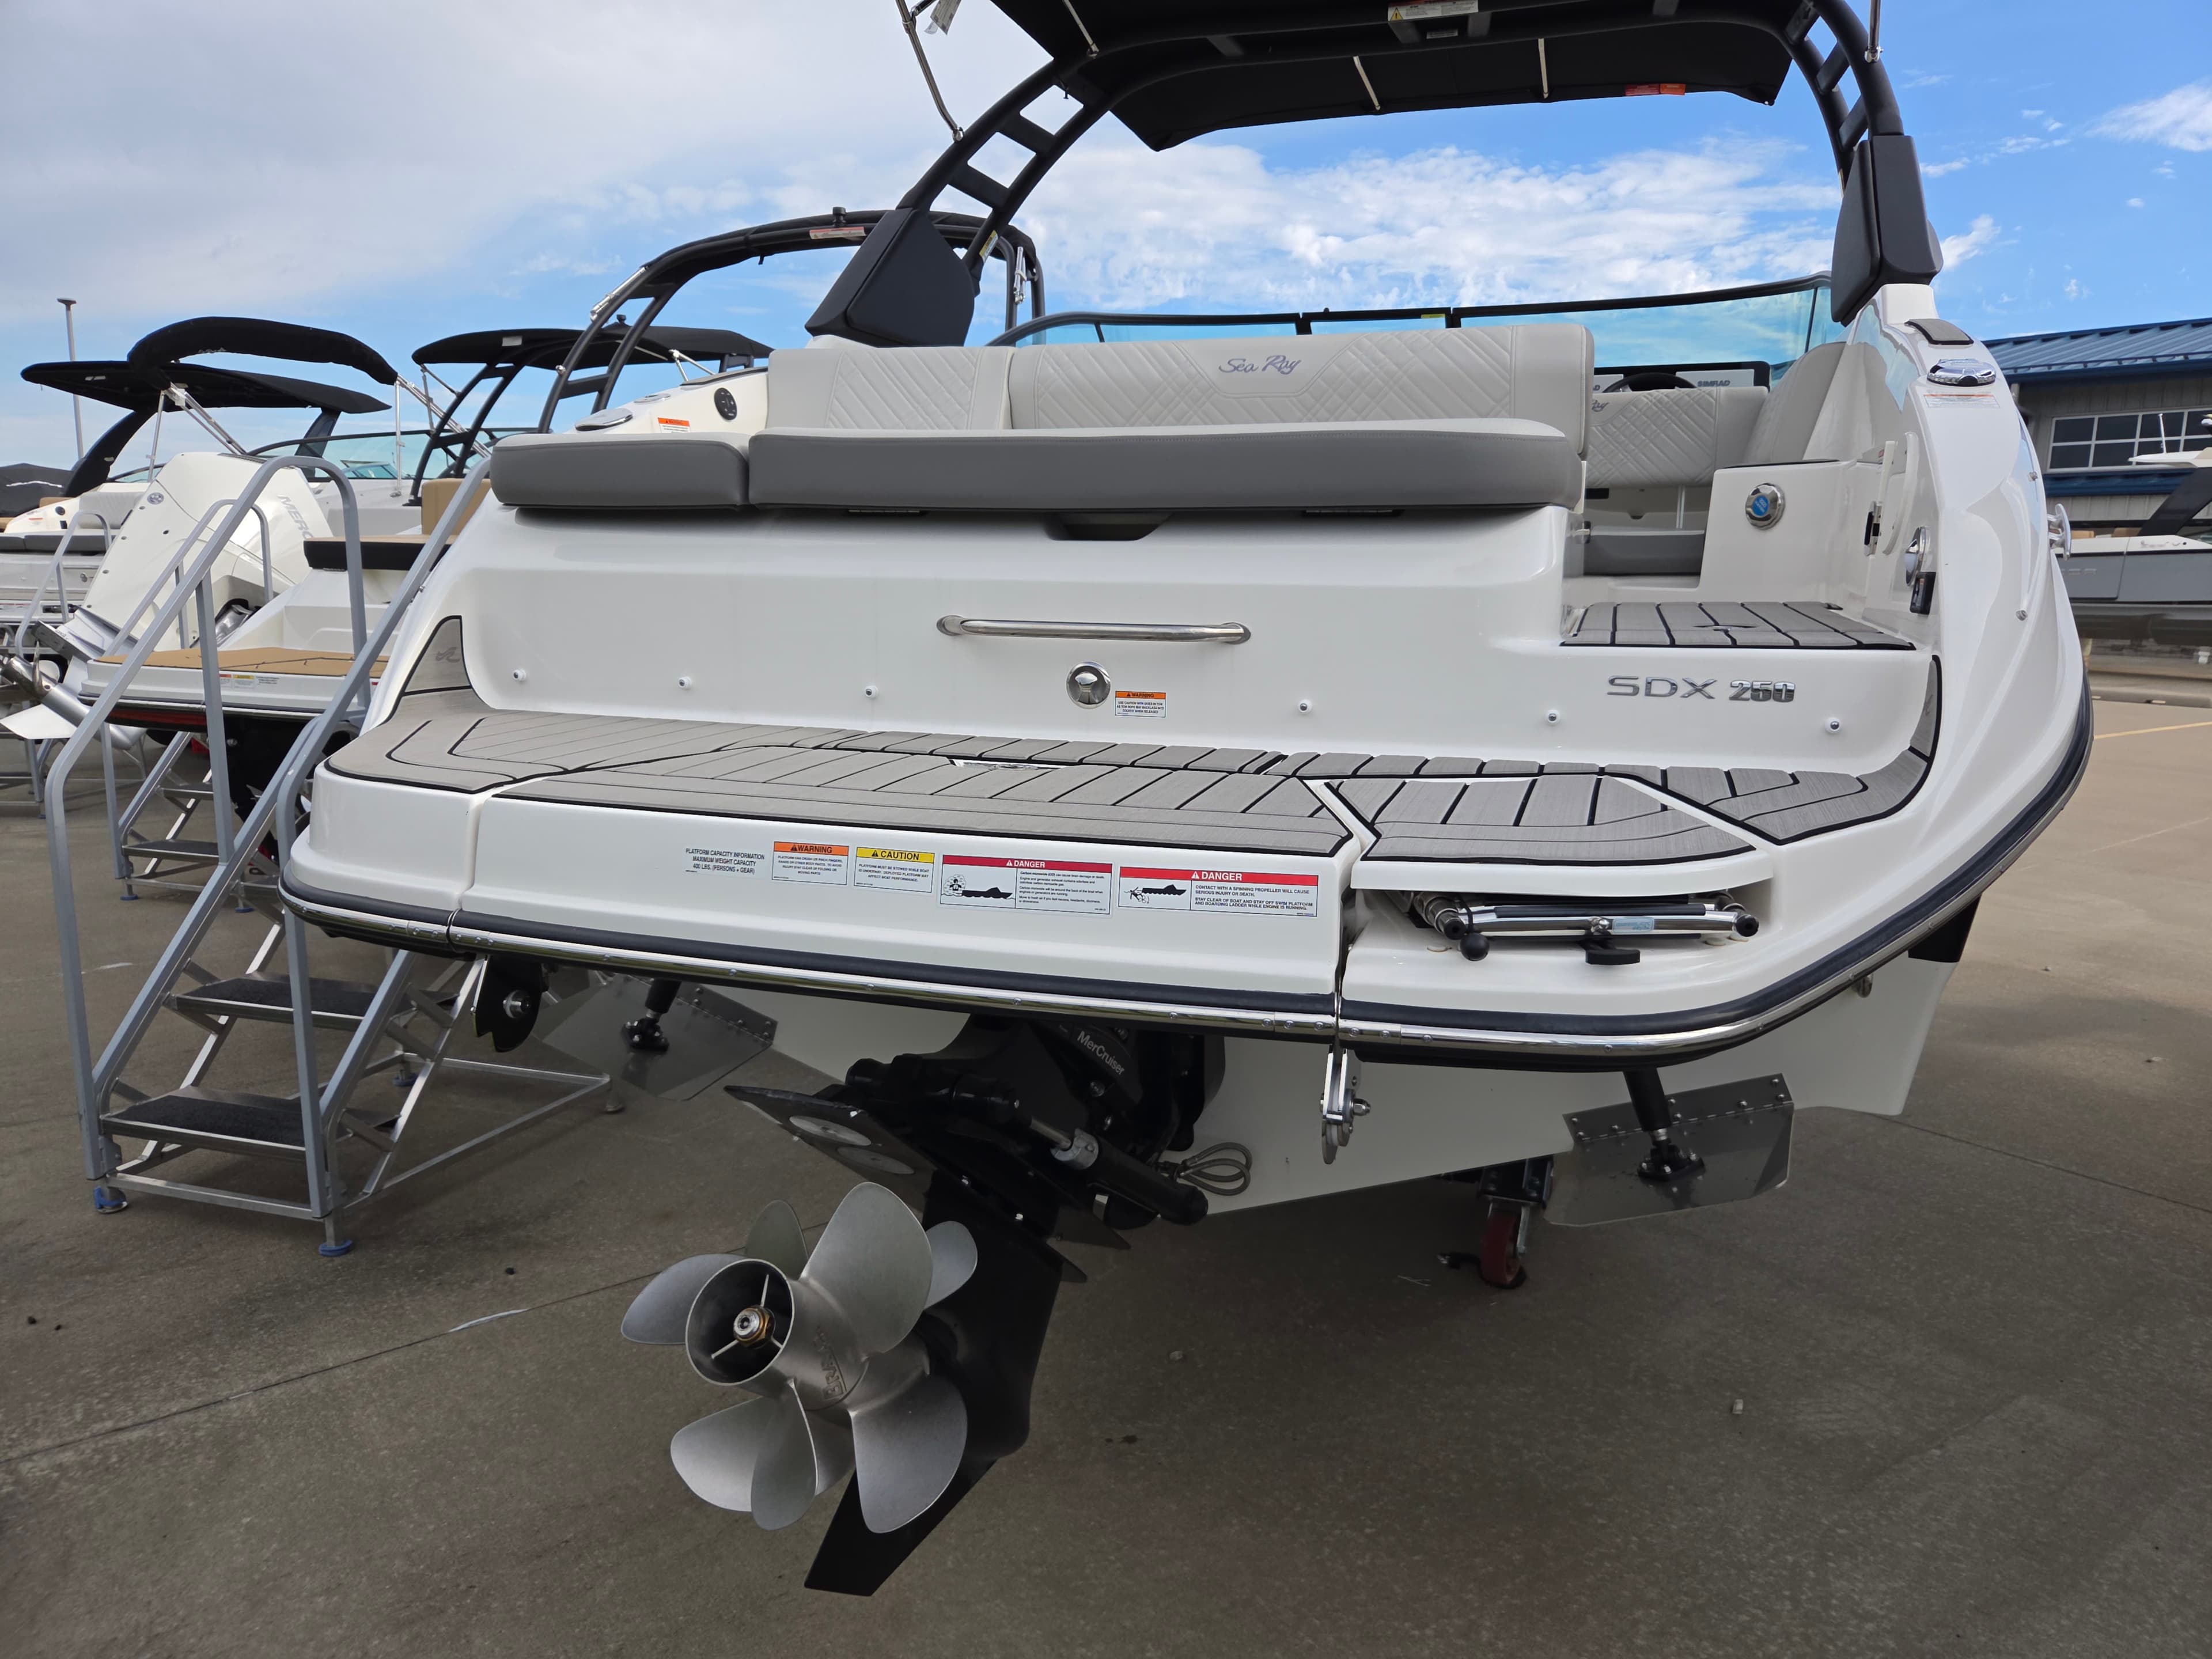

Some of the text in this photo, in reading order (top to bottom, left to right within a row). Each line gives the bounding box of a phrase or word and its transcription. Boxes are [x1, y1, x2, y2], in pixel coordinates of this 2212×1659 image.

[1218, 355, 1301, 374] Sea Ray
[1607, 676, 1796, 702] SDX 250
[798, 845, 832, 853] WARNING
[734, 852, 764, 860] INFORMATION
[881, 850, 919, 861] CAUTION
[1202, 872, 1242, 881] DANGER
[1077, 1031, 1124, 1075] MerCruiser
